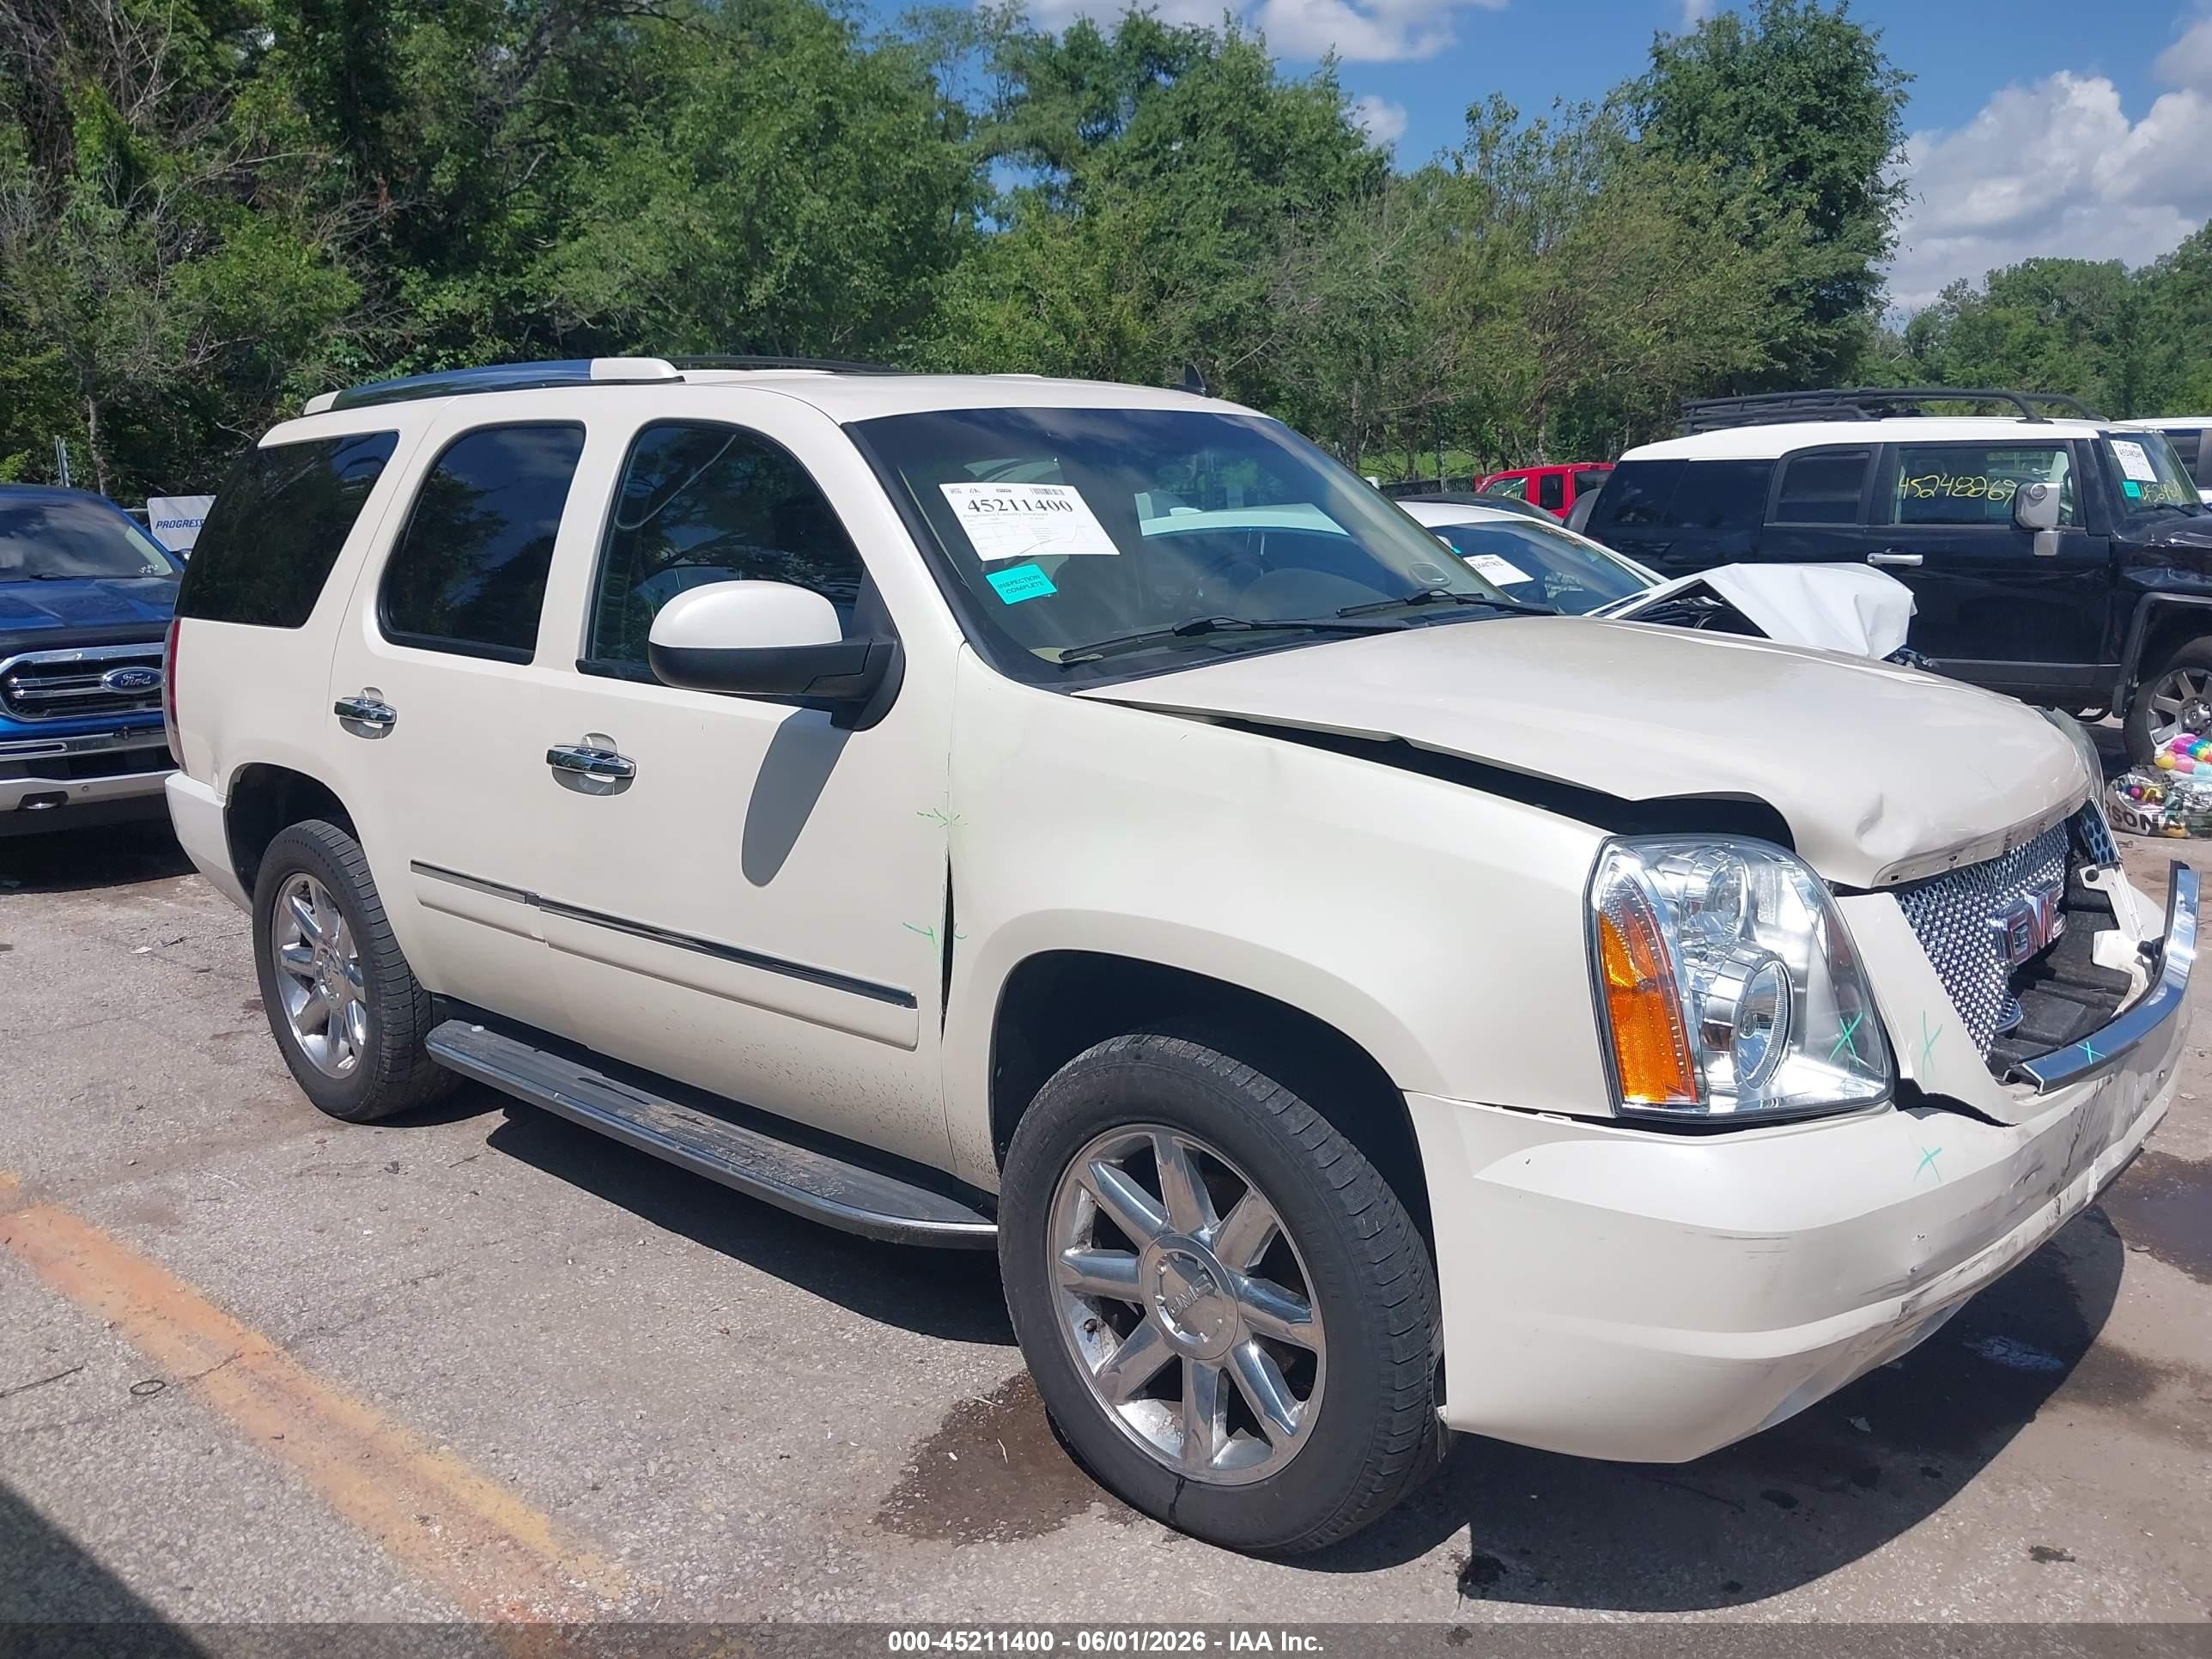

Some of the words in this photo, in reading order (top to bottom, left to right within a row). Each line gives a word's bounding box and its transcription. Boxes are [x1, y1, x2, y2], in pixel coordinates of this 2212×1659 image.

[968, 499, 1073, 513] 45211400
[997, 574, 1041, 589] INSPECTION
[1006, 581, 1045, 594] COMPLETE
[120, 672, 152, 687] Ford
[1991, 878, 2067, 965] GMC
